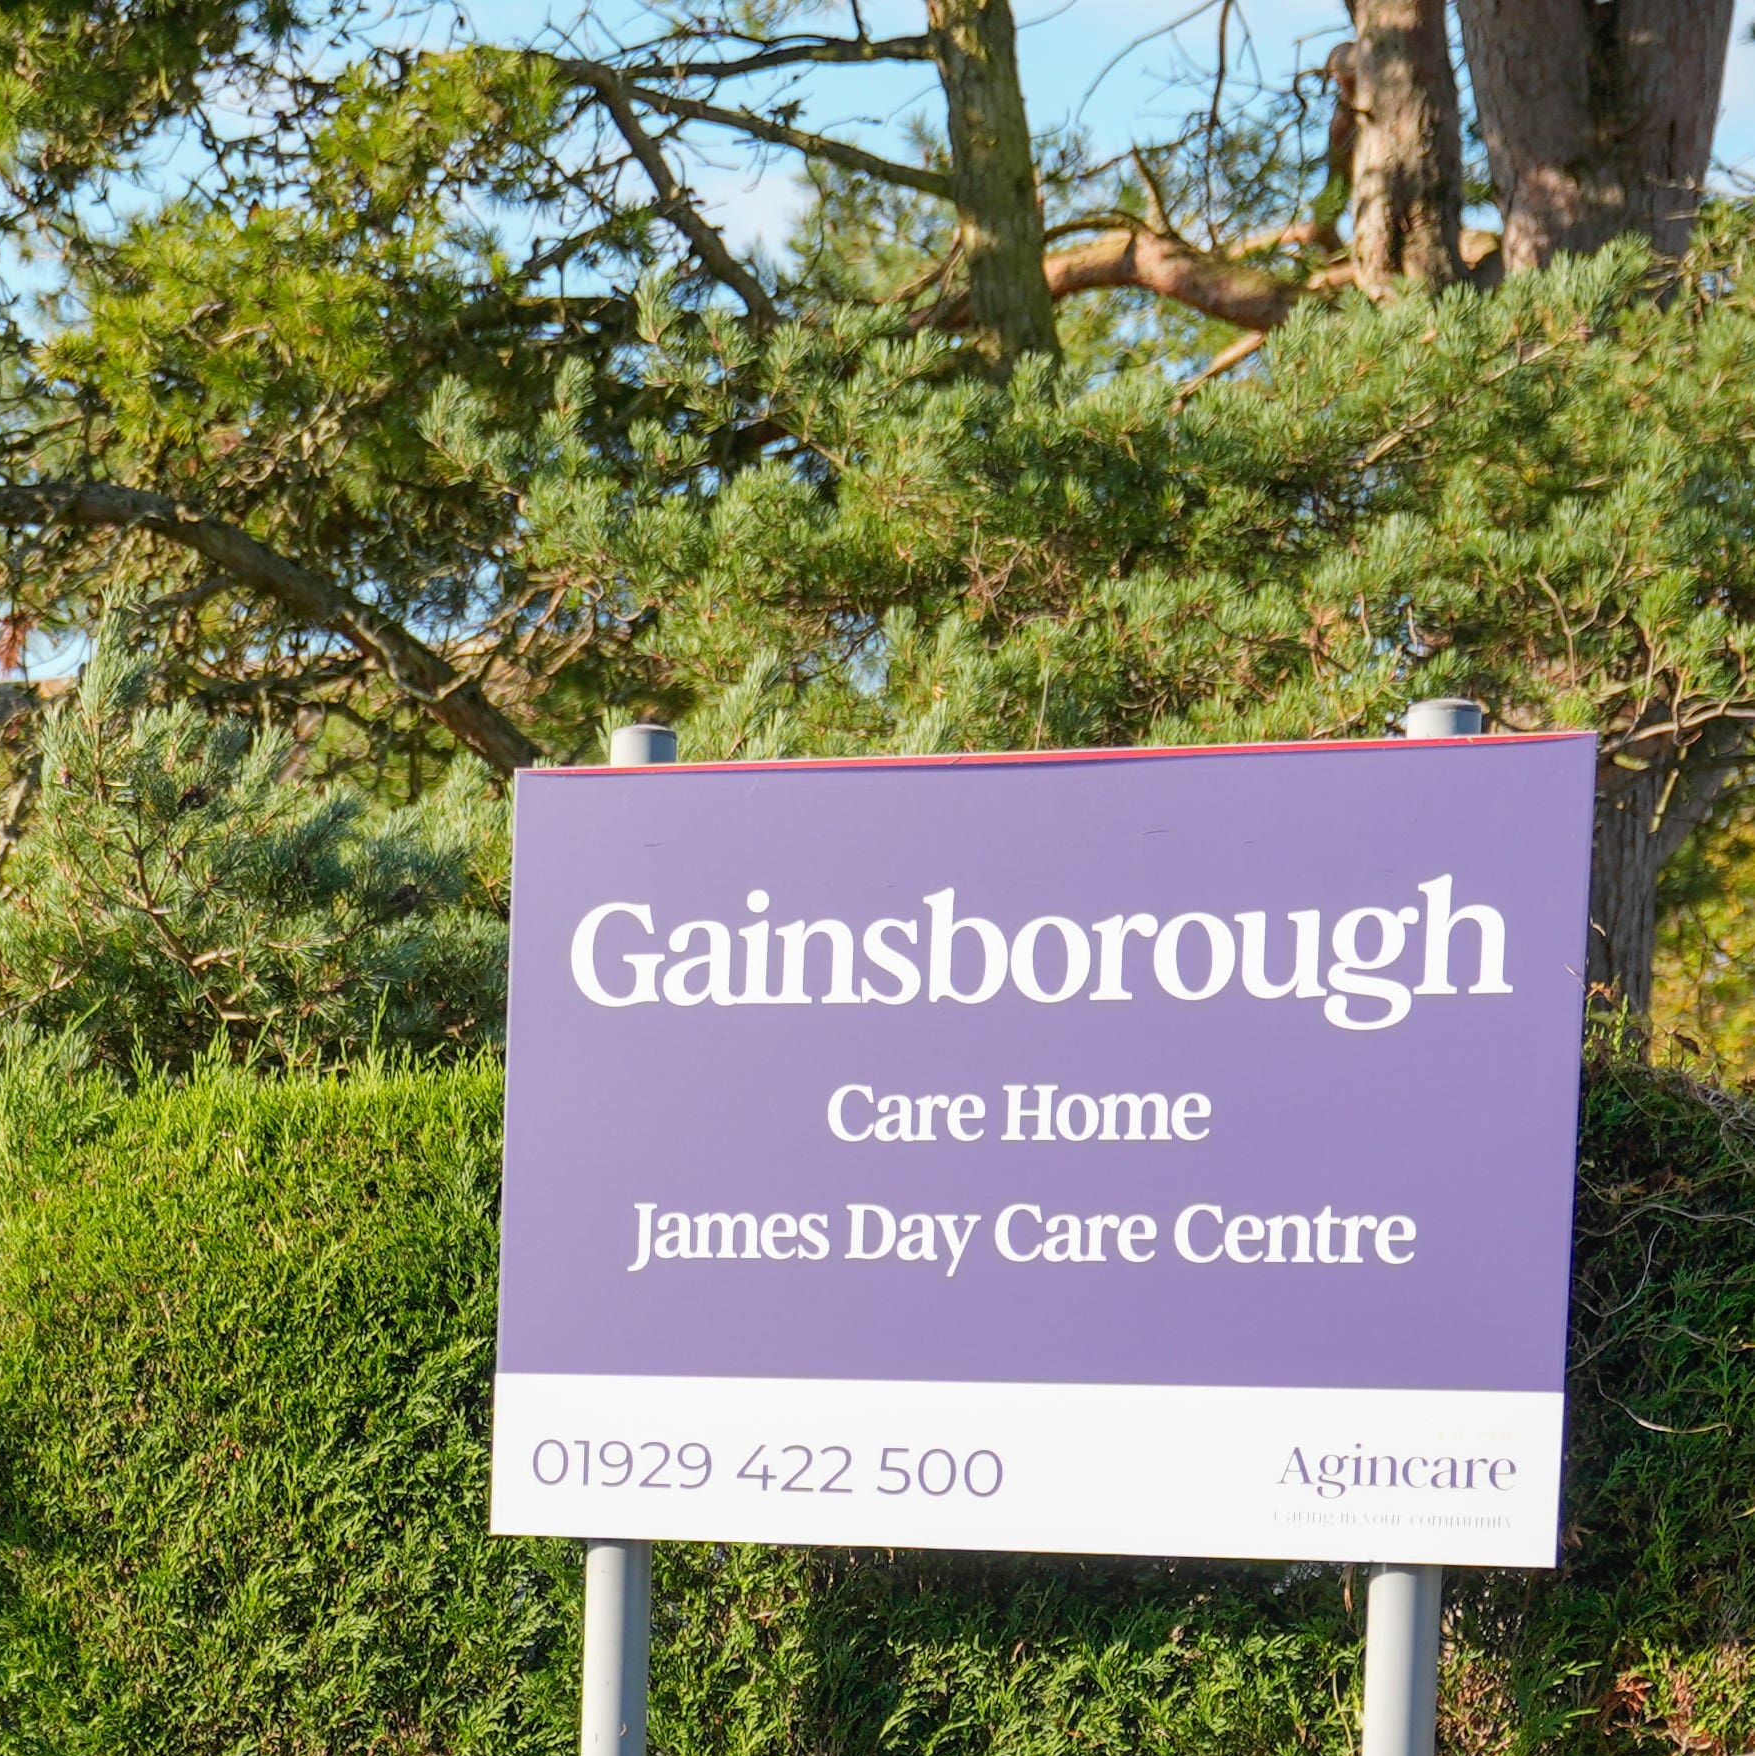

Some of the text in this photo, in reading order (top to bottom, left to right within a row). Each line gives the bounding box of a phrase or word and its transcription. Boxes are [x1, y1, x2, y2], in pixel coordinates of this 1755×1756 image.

[571, 874, 1513, 1031] Gainsborough
[828, 1084, 1211, 1142] Care Home
[627, 1203, 1417, 1277] James Day Care Centre
[532, 1438, 1004, 1498] 01929 422 500
[1276, 1443, 1517, 1499] Agincare
